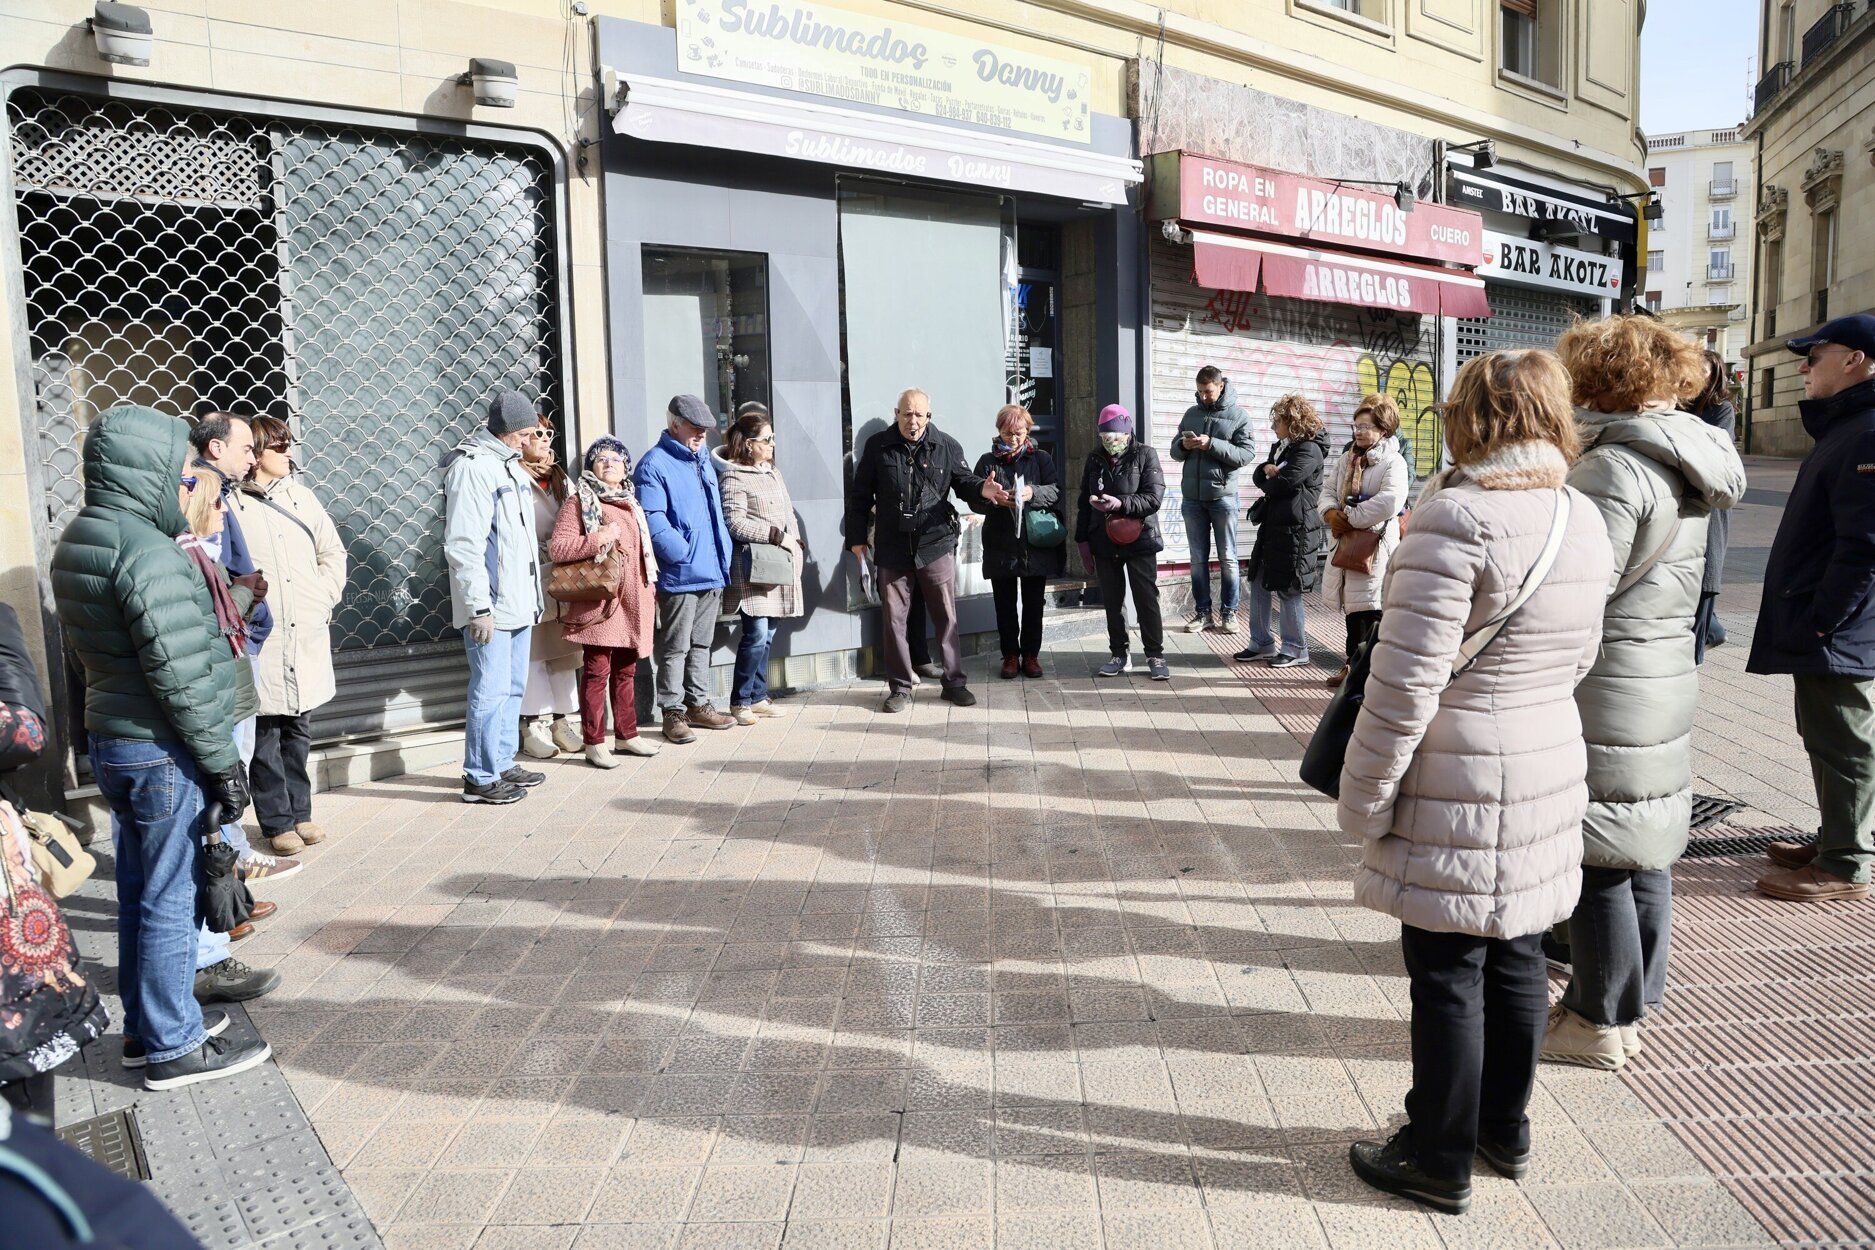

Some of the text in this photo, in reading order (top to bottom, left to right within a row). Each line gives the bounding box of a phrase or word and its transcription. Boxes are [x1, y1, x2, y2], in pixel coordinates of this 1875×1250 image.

[720, 0, 1064, 103] Sublimados Danny
[860, 66, 878, 79] TODO
[880, 69, 890, 82] EN
[785, 131, 1012, 186] Sublimados Danny
[1203, 167, 1275, 199] ROPA EN
[1203, 196, 1279, 227] GENERAL
[1295, 187, 1407, 246] ARREGLOS
[1502, 191, 1538, 219] BAR
[1430, 224, 1470, 247] CUERO
[1500, 243, 1541, 275] BAR
[1549, 253, 1608, 289] AKOTZ
[1303, 264, 1411, 308] ARREGLOS
